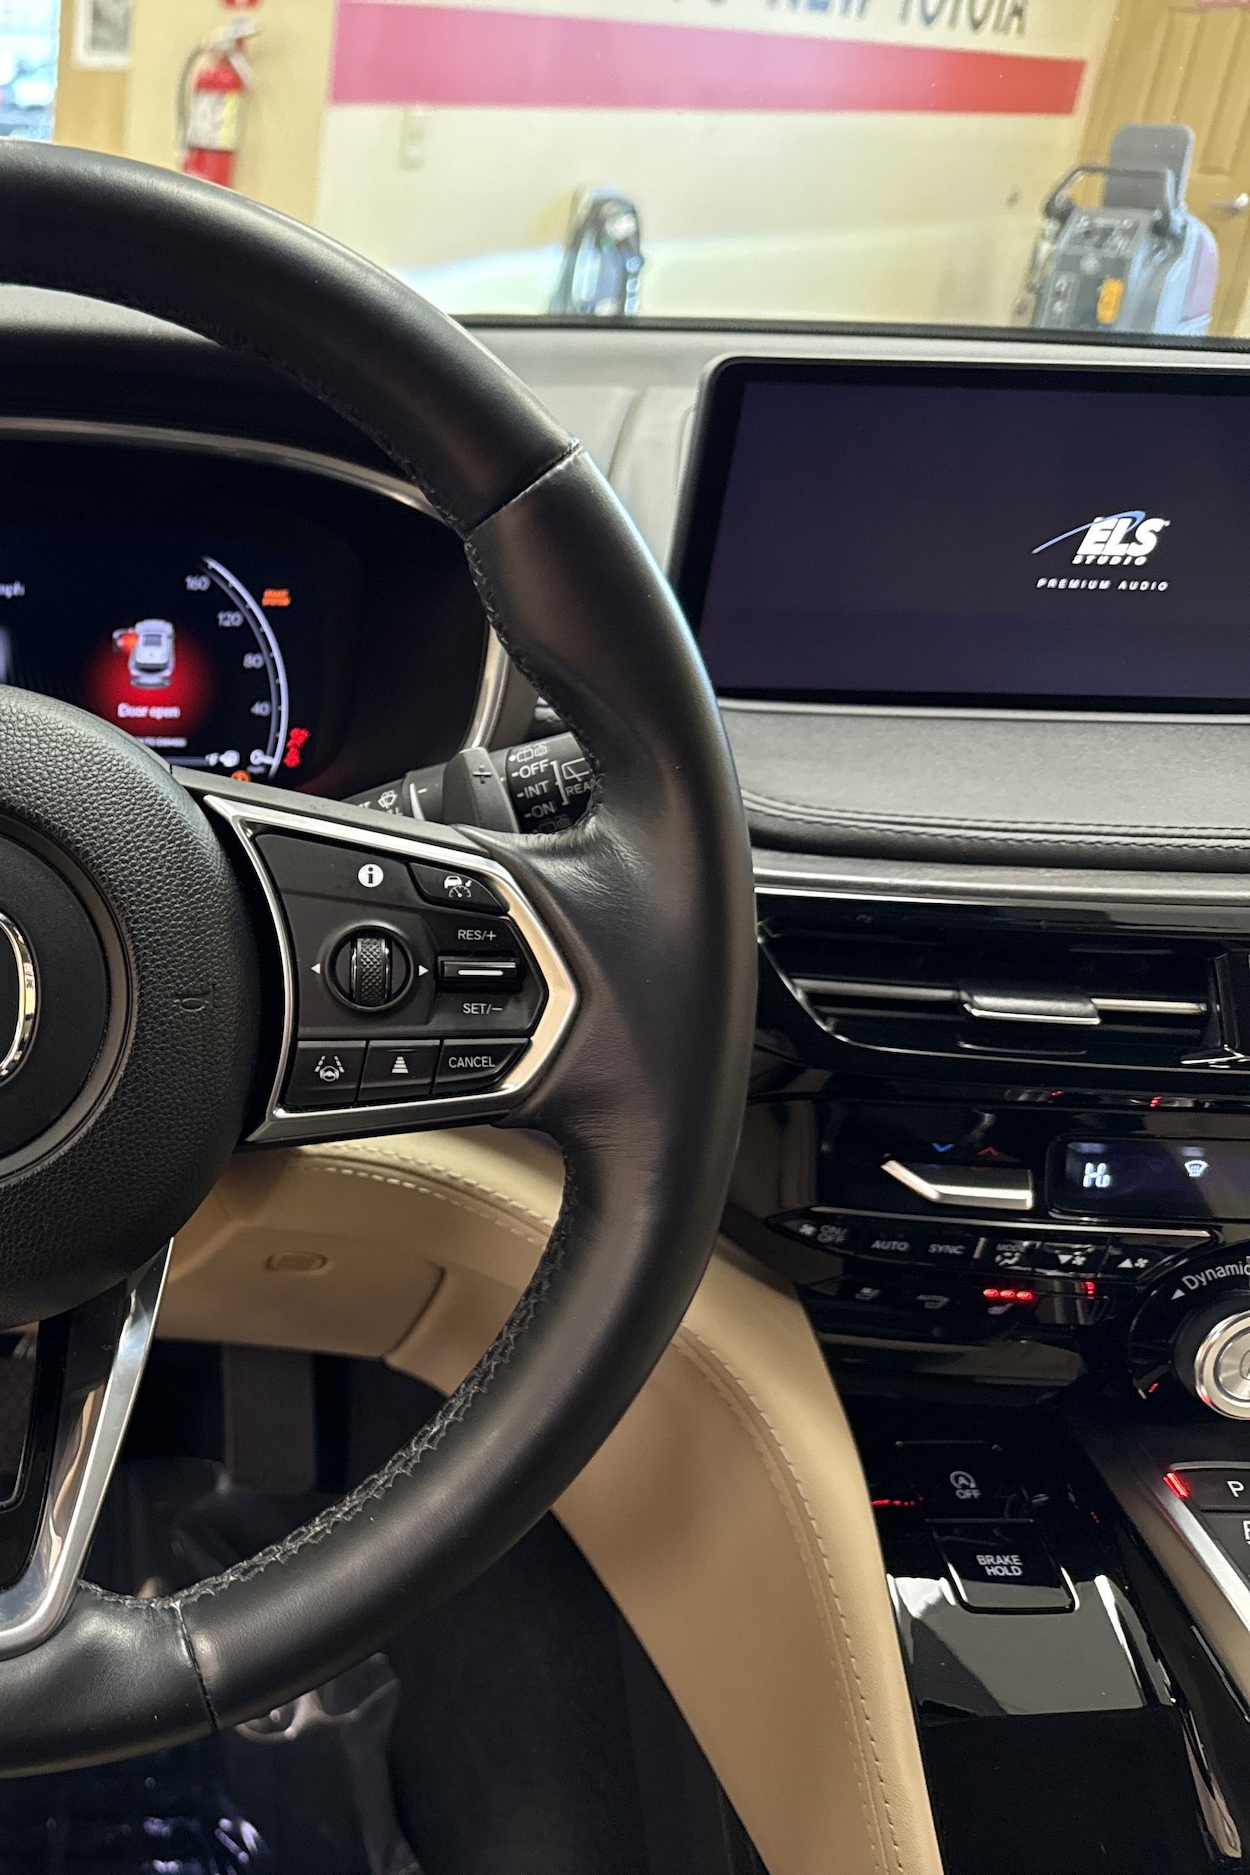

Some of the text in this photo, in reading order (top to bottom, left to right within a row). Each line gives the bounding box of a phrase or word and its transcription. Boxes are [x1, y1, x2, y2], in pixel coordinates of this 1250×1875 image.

[1076, 517, 1165, 557] ELS
[1071, 554, 1148, 566] STUDIO
[1036, 577, 1169, 592] PREMIUM AUDIO
[217, 611, 244, 627] 120
[117, 703, 181, 719] Door open
[519, 759, 550, 780] OFF
[524, 780, 551, 800] INT
[531, 801, 556, 820] ON
[457, 929, 498, 941] RES/+
[448, 1055, 496, 1069] CANCEL
[870, 1239, 910, 1252] AUTO
[928, 1243, 966, 1255] SYNC
[955, 1489, 981, 1500] OFF
[1226, 1480, 1245, 1498] P
[976, 1554, 1023, 1566] BRAKE
[985, 1565, 1023, 1577] HOLD
